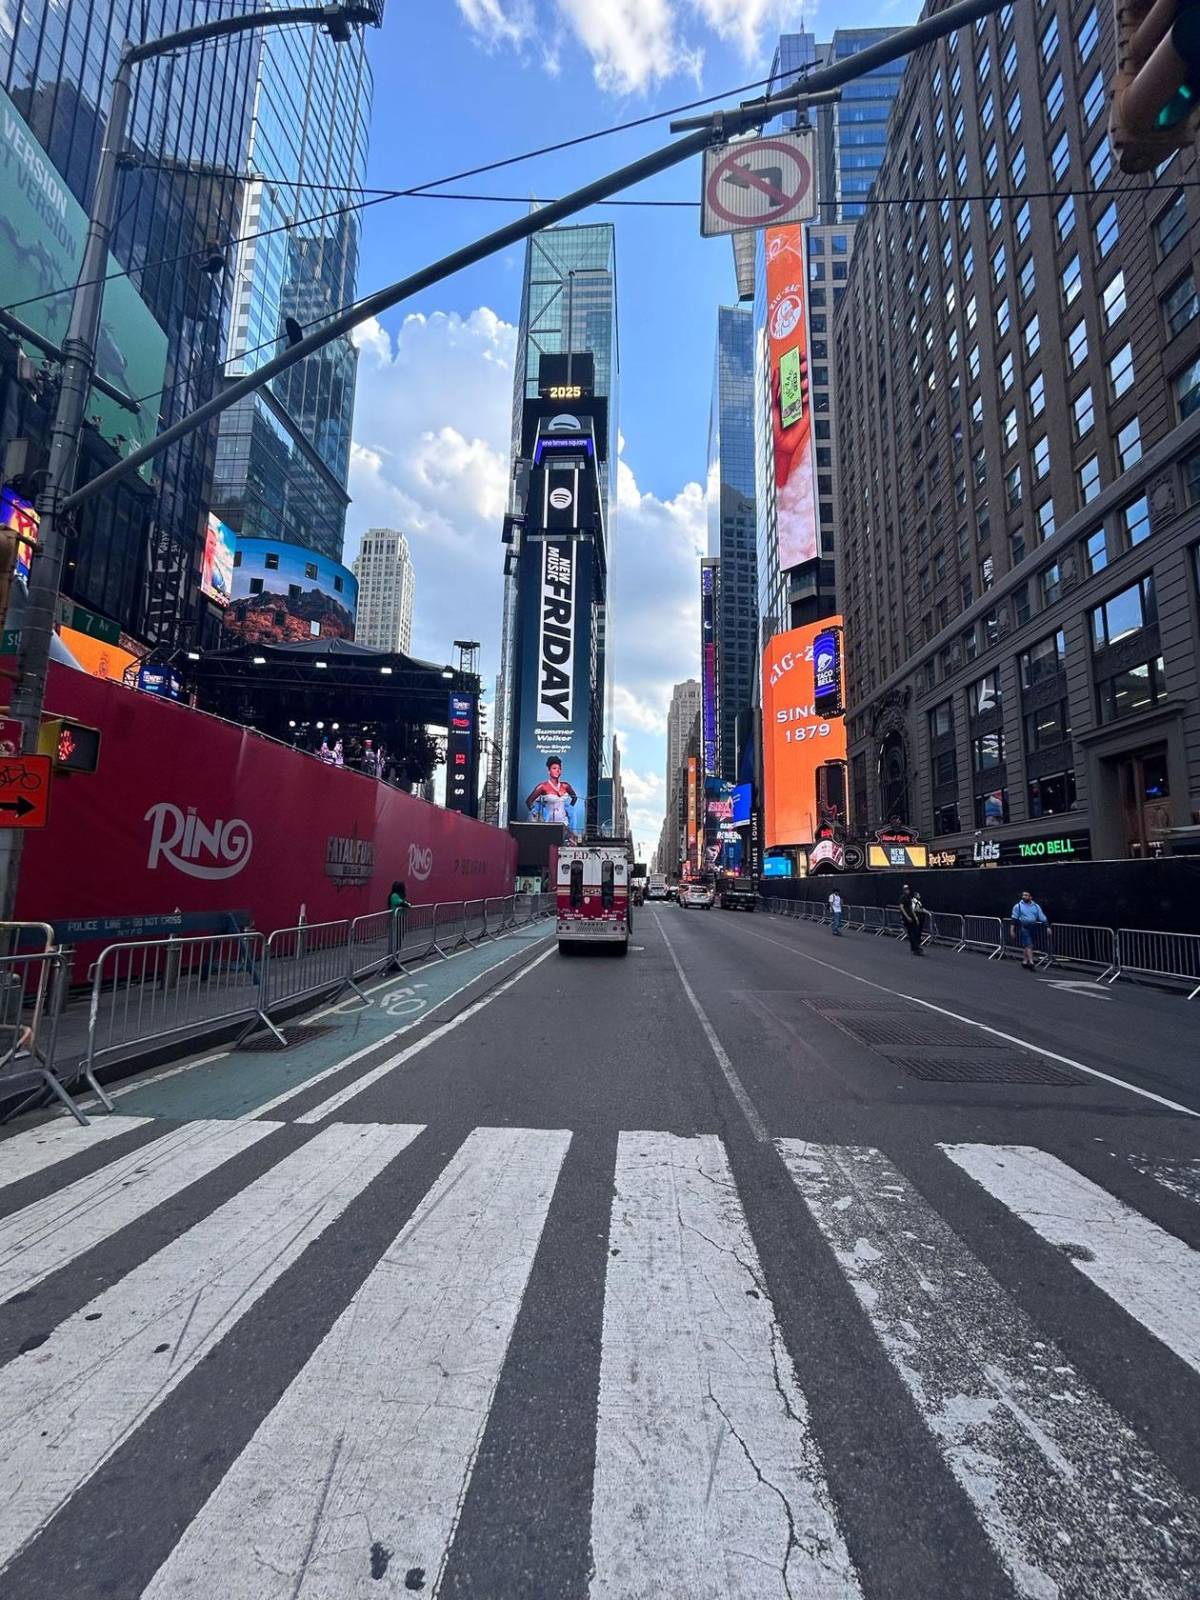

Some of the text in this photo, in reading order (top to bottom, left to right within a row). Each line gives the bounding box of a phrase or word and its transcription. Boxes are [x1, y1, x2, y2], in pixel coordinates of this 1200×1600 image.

[4, 110, 68, 219] VERSION
[17, 161, 77, 260] VERSION
[550, 386, 581, 398] 2025
[547, 546, 560, 582] MUSIC
[558, 557, 571, 585] NEW
[86, 614, 93, 631] 7
[541, 583, 573, 720] FRIDAY
[769, 645, 814, 688] ZIG-Z
[816, 669, 833, 681] TACO
[817, 676, 833, 687] BELL
[785, 723, 831, 743] 1879
[973, 840, 1000, 861] Lids
[1019, 839, 1075, 857] TACO BELL
[68, 921, 98, 931] POLICE
